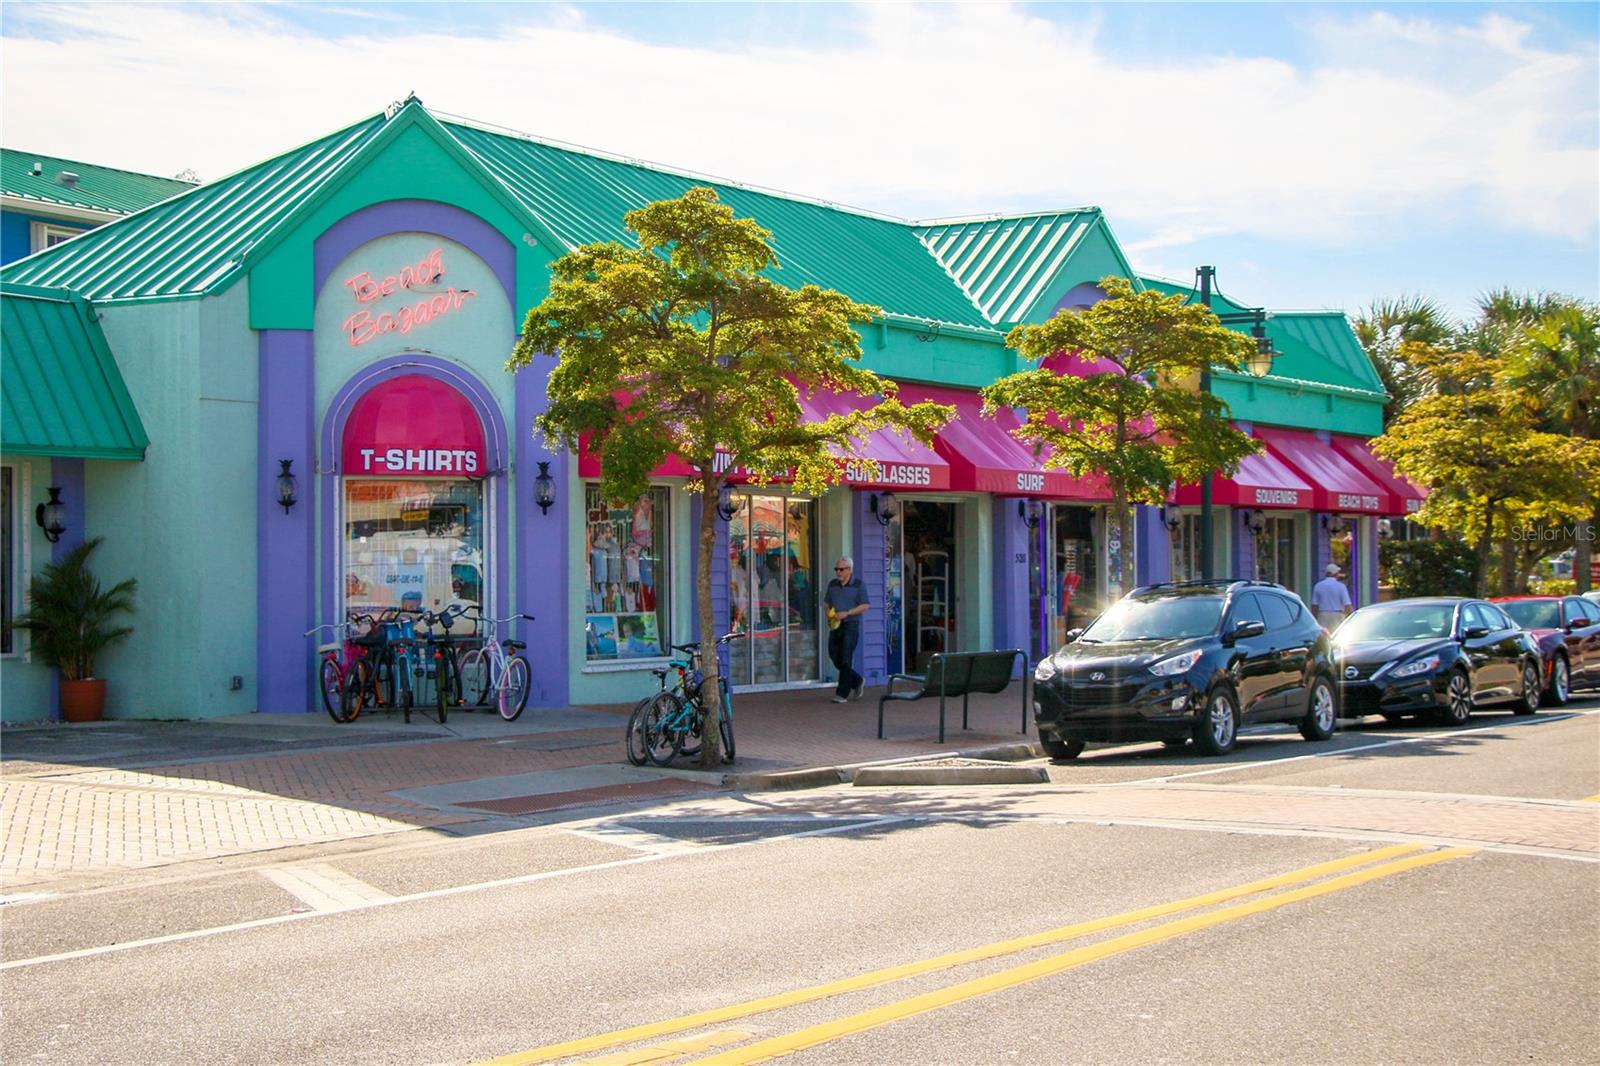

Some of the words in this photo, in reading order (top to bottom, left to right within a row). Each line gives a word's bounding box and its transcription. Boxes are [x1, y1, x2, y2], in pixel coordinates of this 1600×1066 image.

[344, 247, 446, 303] Beach
[342, 287, 476, 347] Bazaar
[360, 448, 477, 472] T-SHIRTS
[1016, 472, 1045, 491] SURF
[1255, 488, 1298, 505] SOUVENIRS
[1338, 493, 1361, 508] BEACH
[1362, 495, 1379, 510] TOYS
